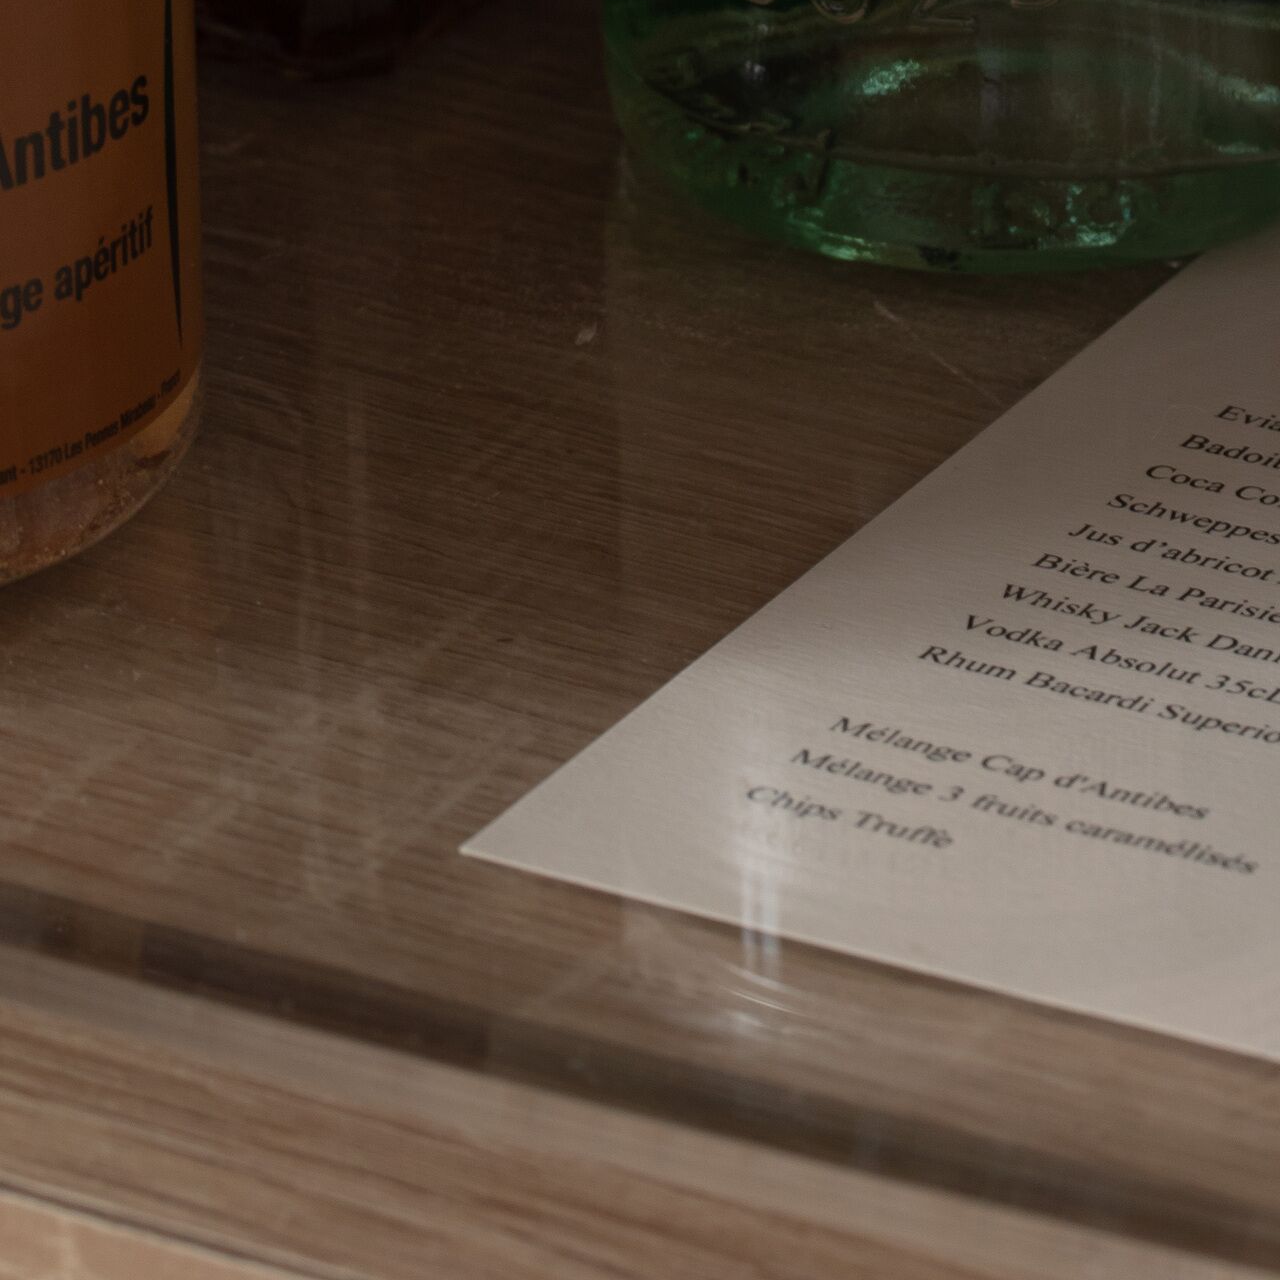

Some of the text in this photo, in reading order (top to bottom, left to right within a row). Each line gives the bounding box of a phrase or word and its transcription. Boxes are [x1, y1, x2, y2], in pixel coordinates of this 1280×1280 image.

[54, 204, 153, 303] apéritif
[1145, 464, 1225, 495] Coca
[1030, 552, 1121, 587] Bière
[1126, 574, 1171, 598] La
[1068, 522, 1123, 547] Jus
[1130, 538, 1276, 584] d'abricot
[1001, 583, 1121, 627] Whisky
[1123, 614, 1196, 646] Jack
[917, 644, 1018, 681] Rhum
[1022, 670, 1153, 715] Bacardi
[963, 613, 1064, 653] Vodka
[1070, 643, 1202, 686] Absolut
[789, 747, 934, 798] Mélange
[969, 793, 1061, 828] fruits
[828, 716, 1211, 822] Mélange Cap d'Antibes
[746, 785, 843, 821] Chips
